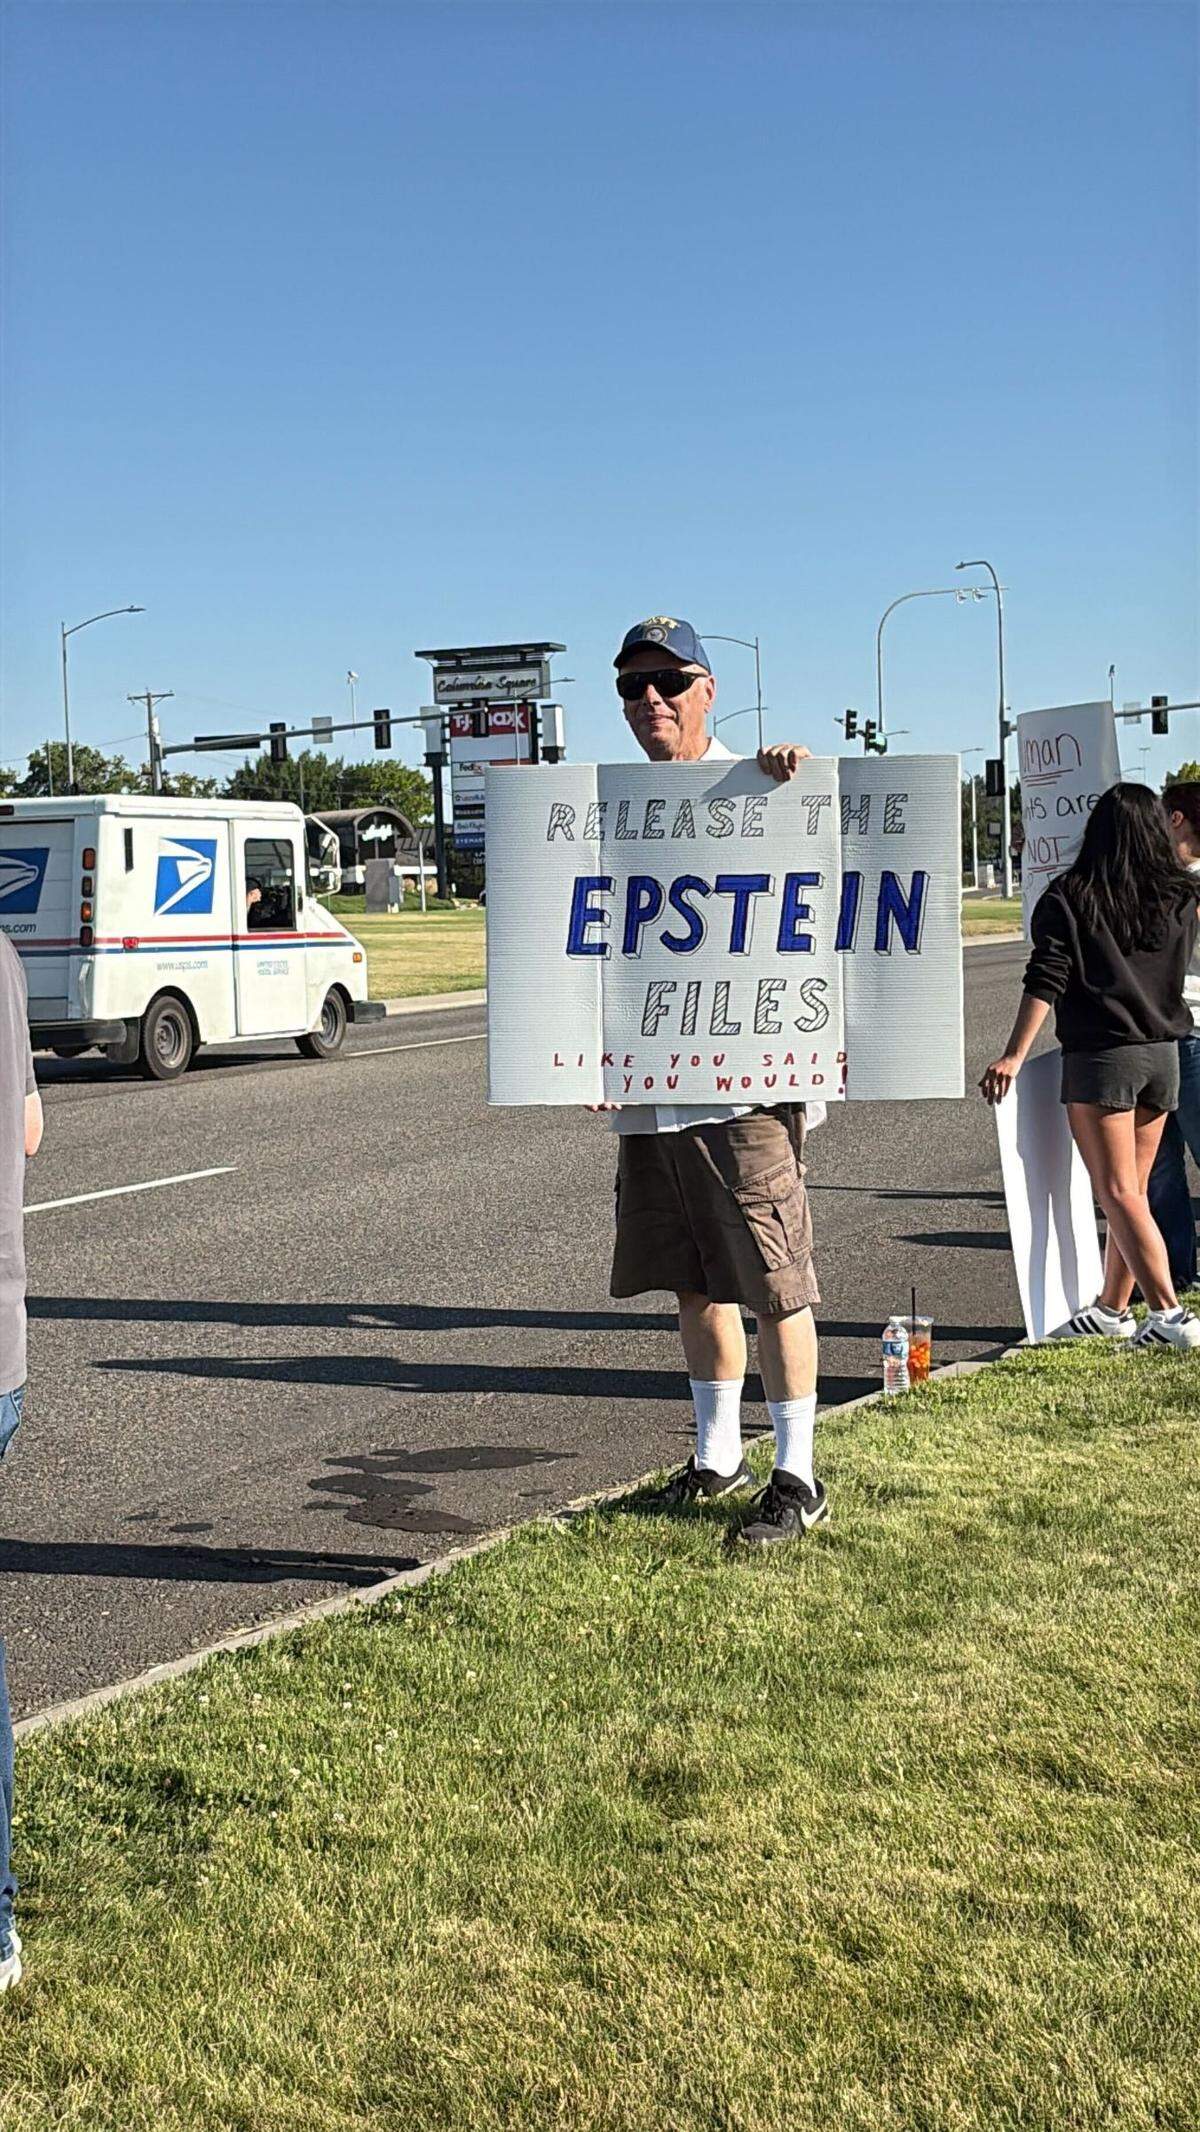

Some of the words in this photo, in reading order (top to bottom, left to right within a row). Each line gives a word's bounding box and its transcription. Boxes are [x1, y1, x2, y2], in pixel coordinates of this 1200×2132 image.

[496, 676, 536, 695] Square
[547, 796, 768, 841] RELEASE
[802, 794, 909, 836] THE
[1056, 793, 1102, 817] are
[1027, 836, 1070, 863] NOT
[566, 871, 931, 960] EPSTEIN
[641, 978, 829, 1036] FILES
[553, 1052, 634, 1068] LIKE
[670, 1053, 726, 1068] YOU
[762, 1052, 847, 1067] SAID
[623, 1074, 678, 1093] YOU
[716, 1064, 848, 1094] WOULD!
